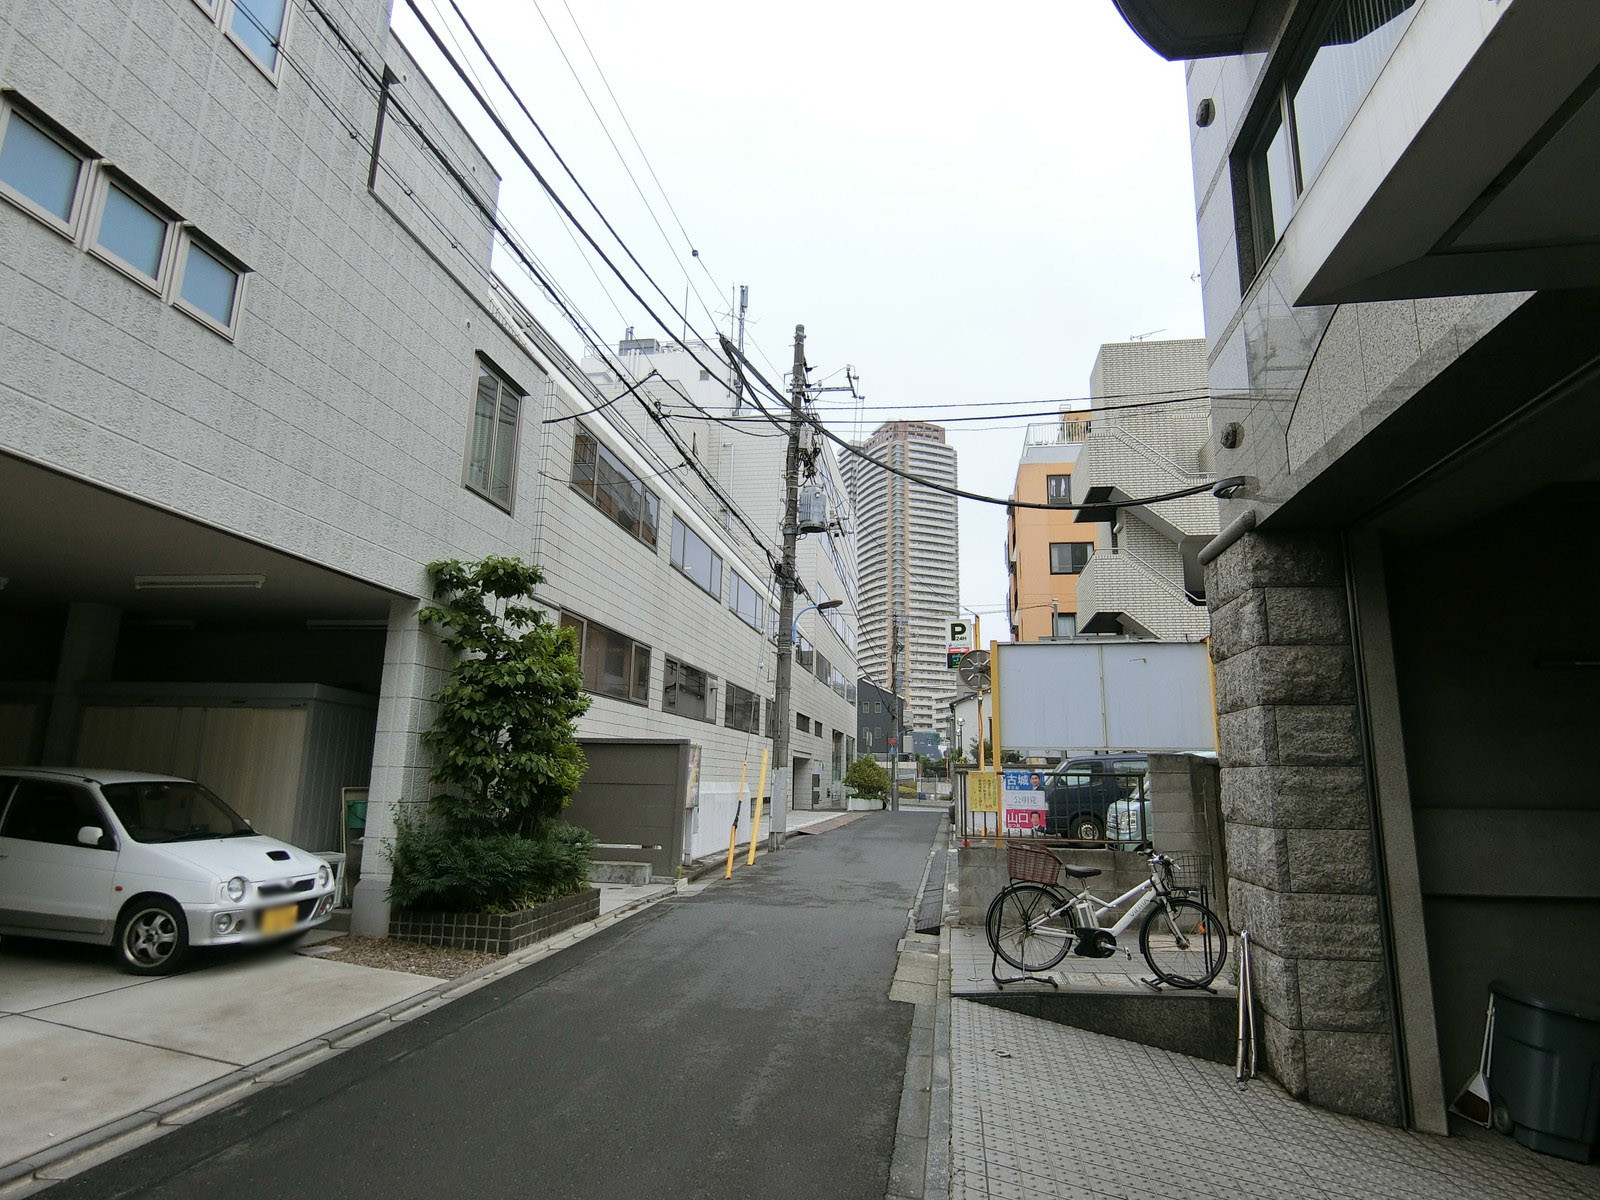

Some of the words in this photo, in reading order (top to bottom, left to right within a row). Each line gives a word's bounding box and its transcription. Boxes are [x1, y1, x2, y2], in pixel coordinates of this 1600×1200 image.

[951, 623, 966, 641] P
[1006, 774, 1029, 786] 古城
[1014, 795, 1037, 804] 公明党
[1007, 812, 1029, 823] 山口
